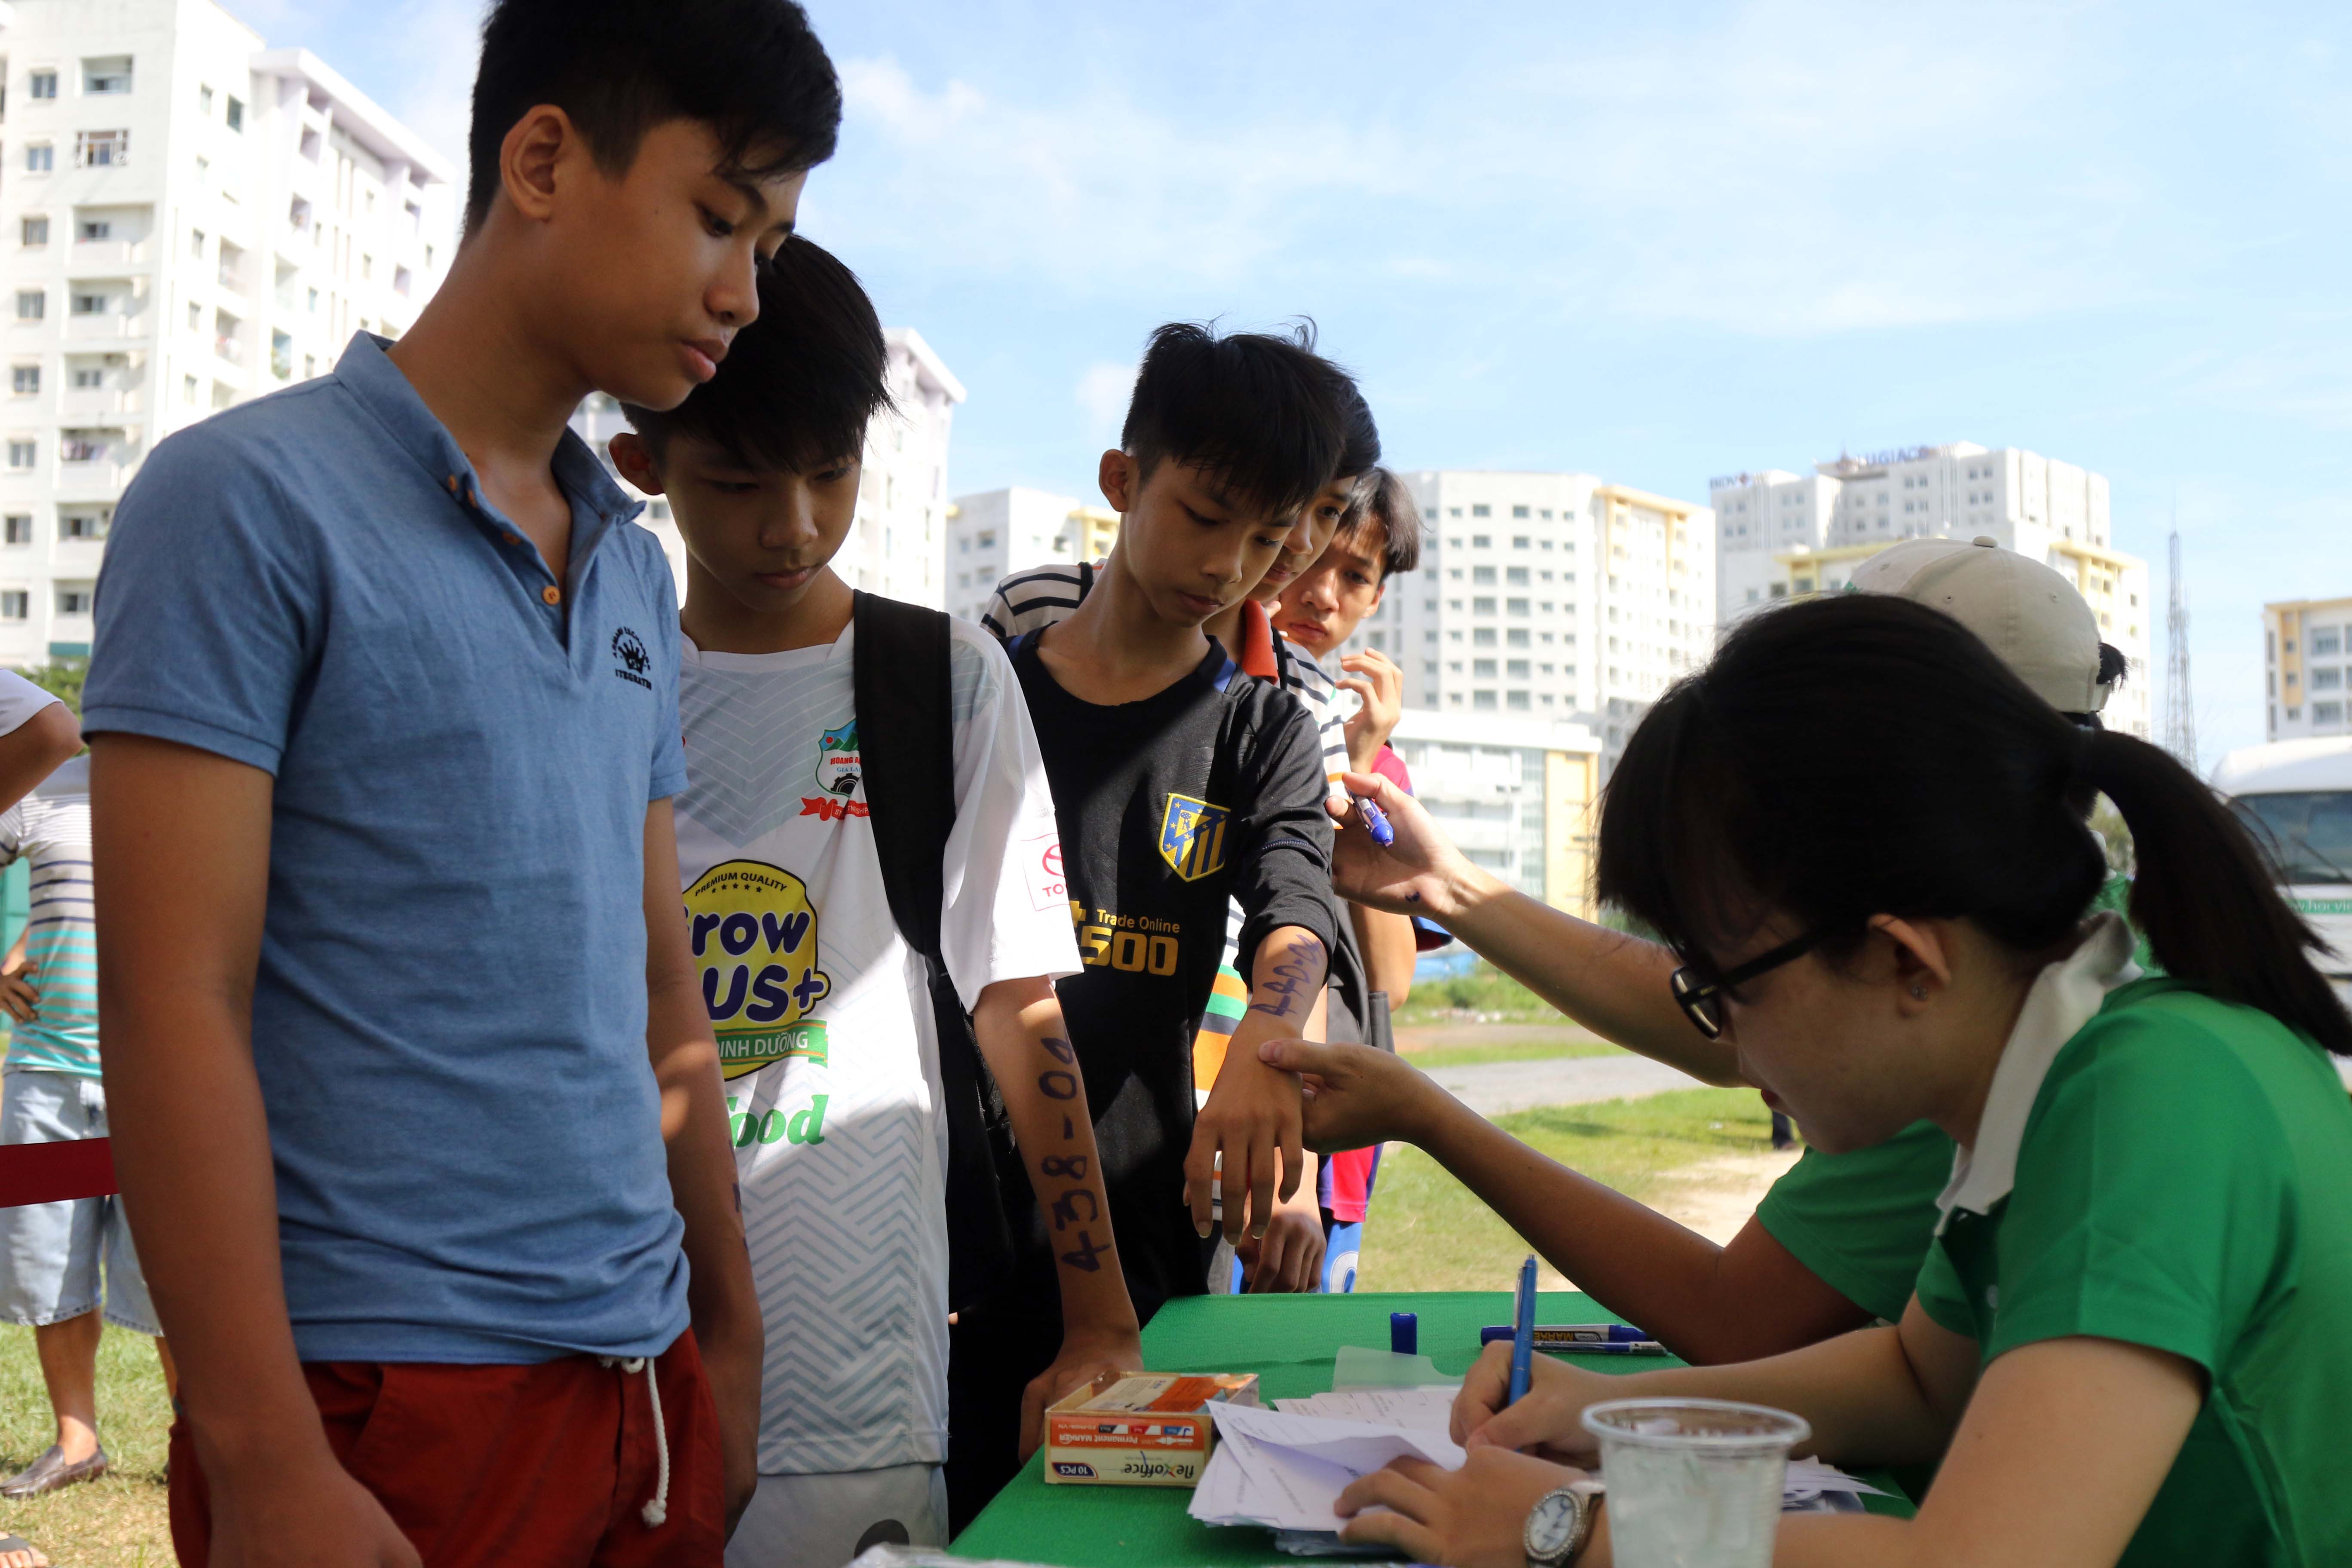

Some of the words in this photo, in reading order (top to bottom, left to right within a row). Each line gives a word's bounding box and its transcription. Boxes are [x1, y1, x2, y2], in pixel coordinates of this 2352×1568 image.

[830, 756, 853, 765] HOANG
[695, 872, 738, 897] PREMIUM
[740, 872, 788, 892] QUALITY
[1042, 883, 1067, 897] TO
[1096, 908, 1135, 928] Trade
[1139, 916, 1180, 934] Online
[684, 906, 810, 956] row
[717, 1038, 750, 1059] INH
[754, 1031, 808, 1055] DƯỠNG
[1533, 1331, 1574, 1341] MARKE
[1059, 1433, 1093, 1442] MARKER
[1060, 1465, 1077, 1474] PCS
[1078, 1465, 1088, 1474] 10
